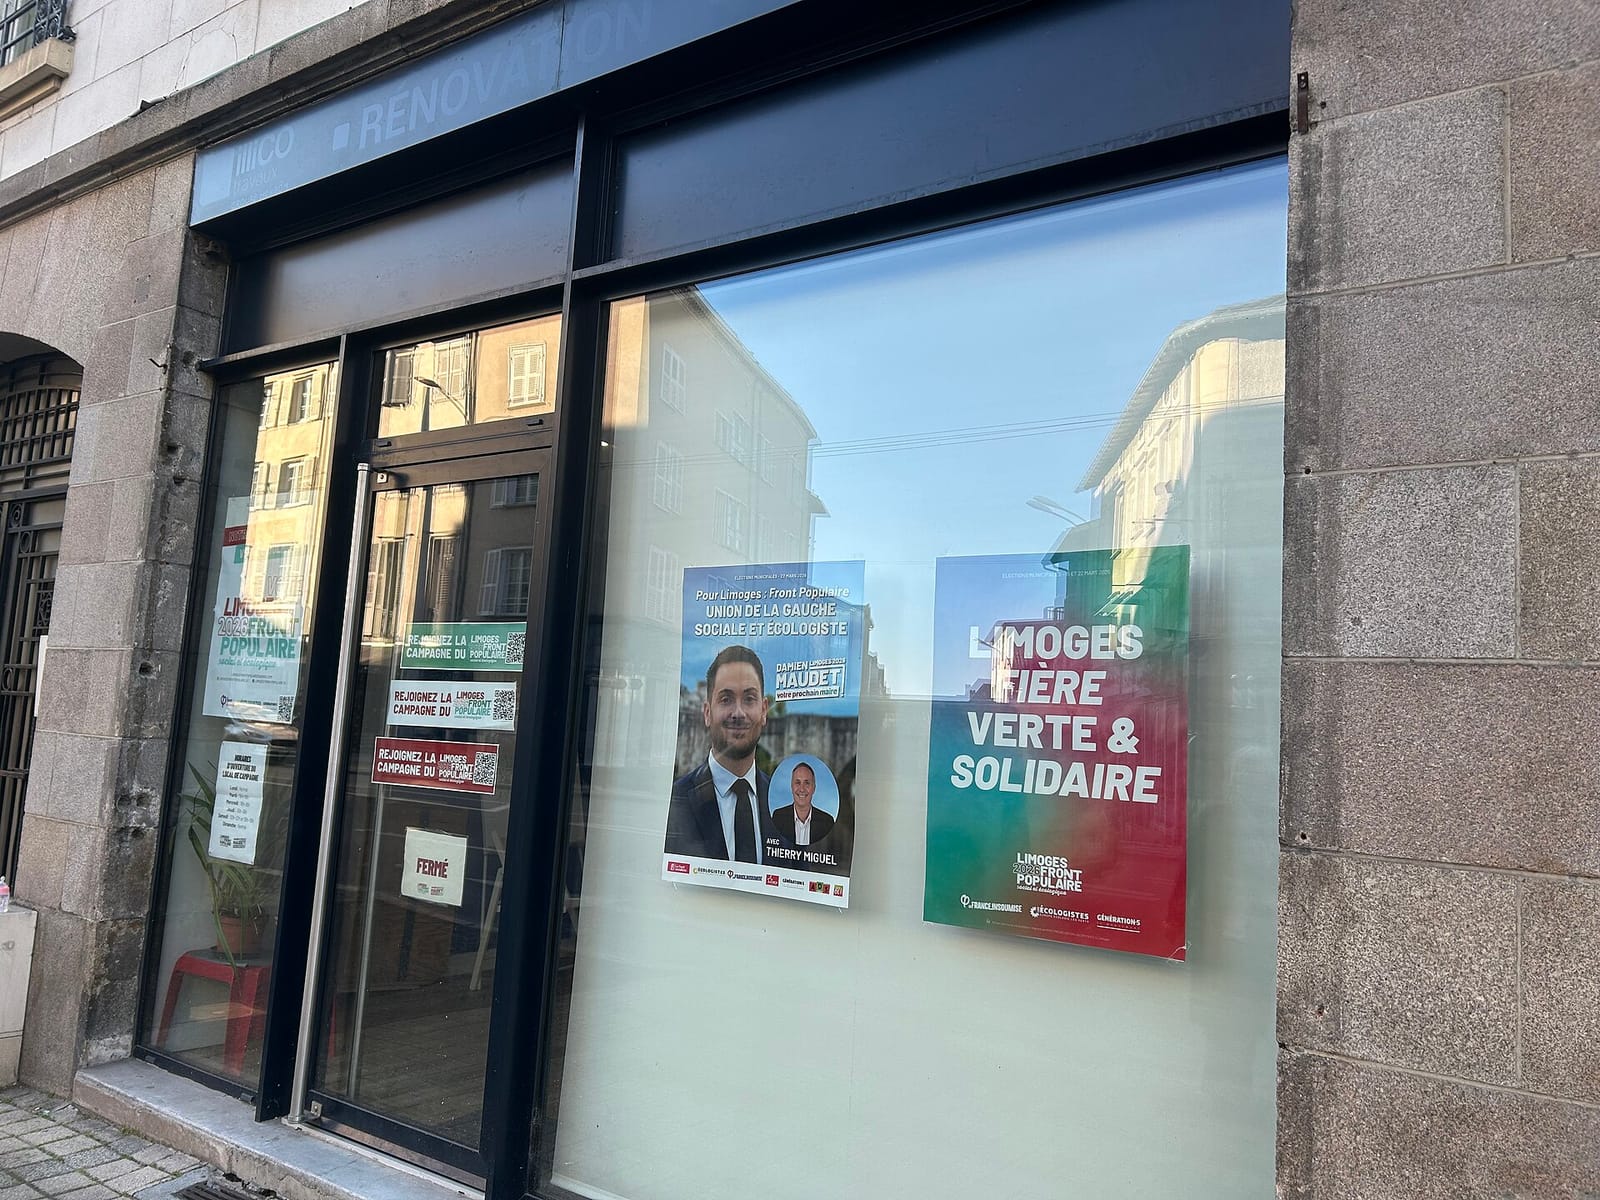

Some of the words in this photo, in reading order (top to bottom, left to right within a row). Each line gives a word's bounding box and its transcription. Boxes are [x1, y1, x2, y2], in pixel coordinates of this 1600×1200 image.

[358, 0, 653, 150] RÉNOVATION
[696, 590, 718, 600] Pour
[720, 589, 762, 602] Limoges
[769, 588, 796, 599] Front
[799, 586, 850, 600] Populaire
[706, 604, 742, 618] UNION
[744, 604, 761, 618] DE
[764, 604, 780, 618] LA
[783, 602, 836, 618] GAUCHE
[694, 622, 746, 637] SOCIALE
[749, 622, 764, 636] ET
[767, 620, 849, 636] ÉCOLOGISTE
[408, 634, 452, 646] REJOIGNEZ
[455, 635, 467, 646] LA
[470, 635, 500, 644] LIMOGES
[483, 643, 507, 651] FRONT
[968, 624, 1144, 660] LIMOGES
[220, 637, 297, 658] POPULAIRE
[406, 648, 452, 659] CAMPAGNE
[454, 648, 466, 660] DU
[470, 650, 507, 659] POPULAIRE
[776, 660, 808, 673] DAMIEN
[776, 668, 842, 690] MAUDET
[1003, 662, 1107, 706] FIÈRE
[394, 691, 438, 703] REJOIGNEZ
[440, 692, 452, 704] LA
[456, 691, 485, 700] LIMOGES
[792, 688, 819, 698] prochain
[820, 687, 838, 696] maire
[393, 704, 437, 716] CAMPAGNE
[440, 706, 451, 717] DU
[454, 706, 492, 716] POPULAIRE
[468, 700, 492, 708] FRONT
[967, 711, 1098, 752] VERTE
[1107, 717, 1140, 754] &
[378, 749, 422, 762] REJOIGNEZ
[424, 752, 436, 764] LA
[440, 754, 467, 764] LIMOGES
[377, 762, 421, 776] CAMPAGNE
[424, 766, 436, 777] DU
[438, 769, 474, 780] POPULAIRE
[451, 763, 474, 772] FRONT
[950, 754, 1162, 804] SOLIDAIRE
[766, 838, 780, 846] AVEC
[766, 846, 802, 861] THIERRY
[804, 852, 838, 866] MIGUEL
[1016, 852, 1068, 868] LIMOGES
[416, 858, 449, 878] FERMÉ
[1013, 863, 1040, 874] 2026
[1040, 866, 1083, 881] FRONT
[1016, 873, 1082, 892] POPULAIRE
[1040, 904, 1090, 920] ÉCOLOGISTES
